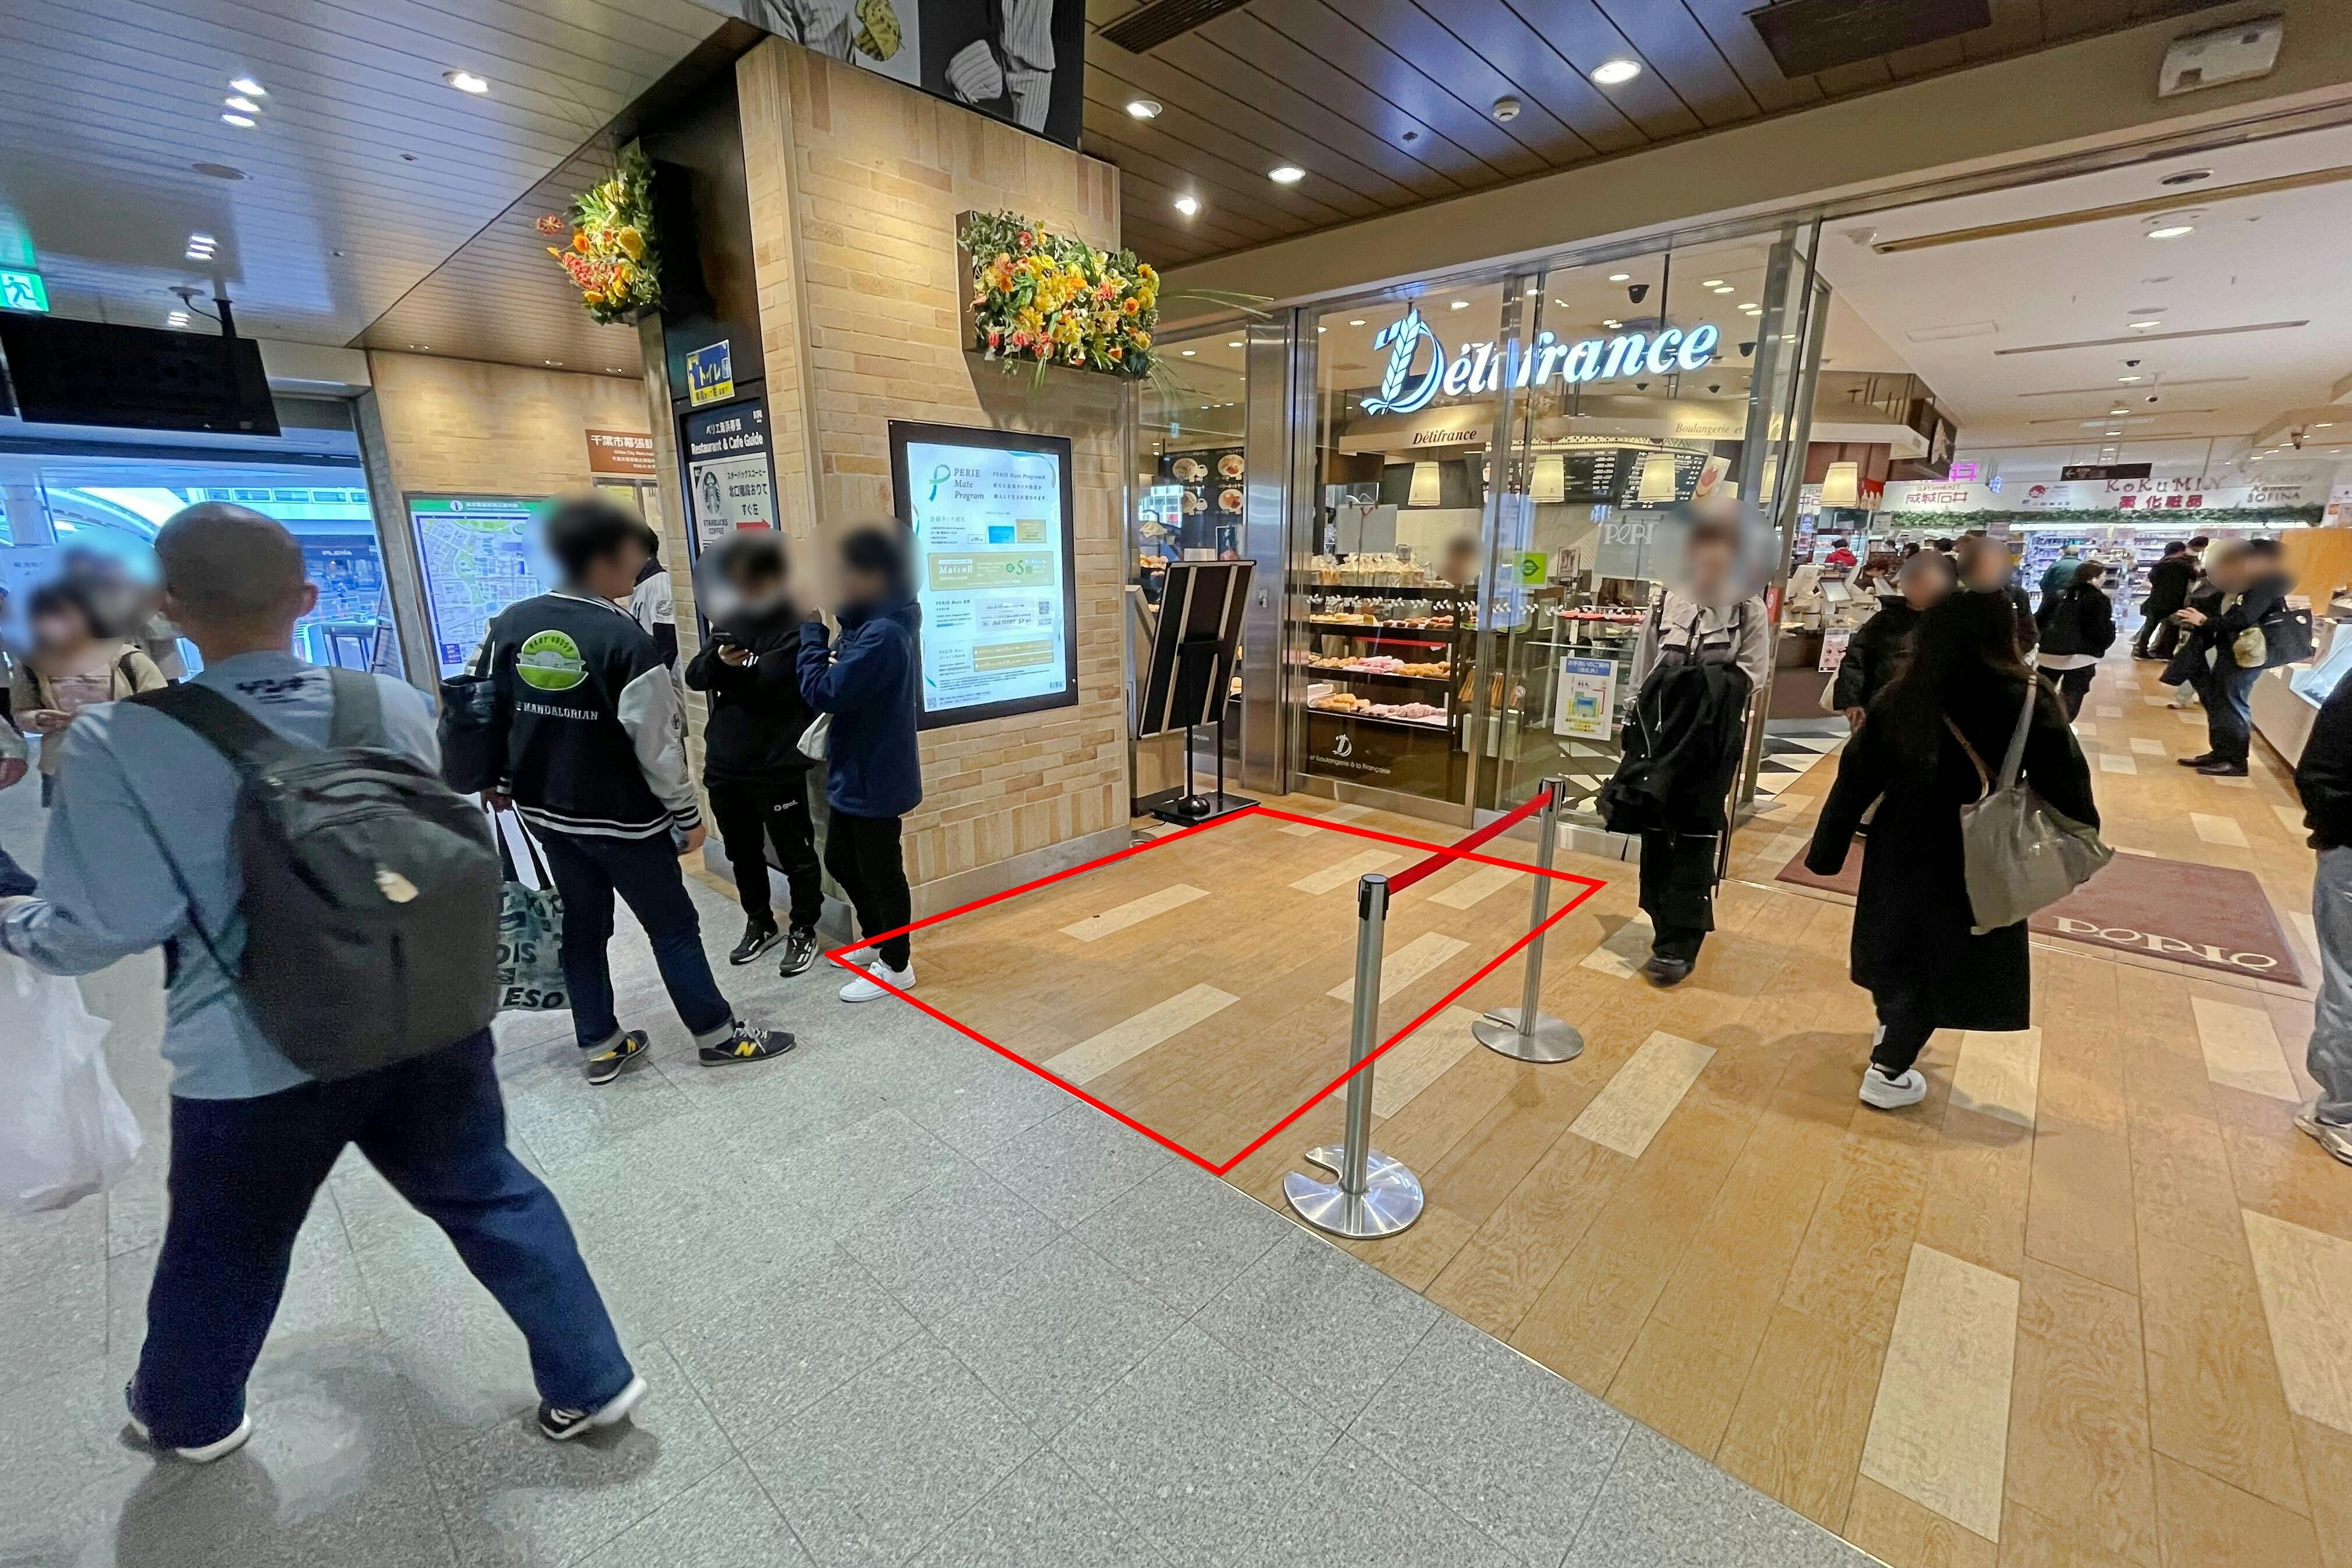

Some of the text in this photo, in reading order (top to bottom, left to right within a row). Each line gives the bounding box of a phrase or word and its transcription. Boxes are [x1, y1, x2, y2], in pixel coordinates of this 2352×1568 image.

[1359, 308, 1719, 416] Délifrance
[1675, 423, 1743, 435] Boulangerie et
[691, 431, 764, 455] Restaurant & Cafe Guide
[1412, 428, 1478, 446] Délifrance
[954, 468, 981, 477] PERIE
[954, 480, 974, 488] Mate
[955, 491, 984, 501] Program
[2247, 492, 2300, 503] SOFINA
[523, 702, 598, 720] MANDALORIAN
